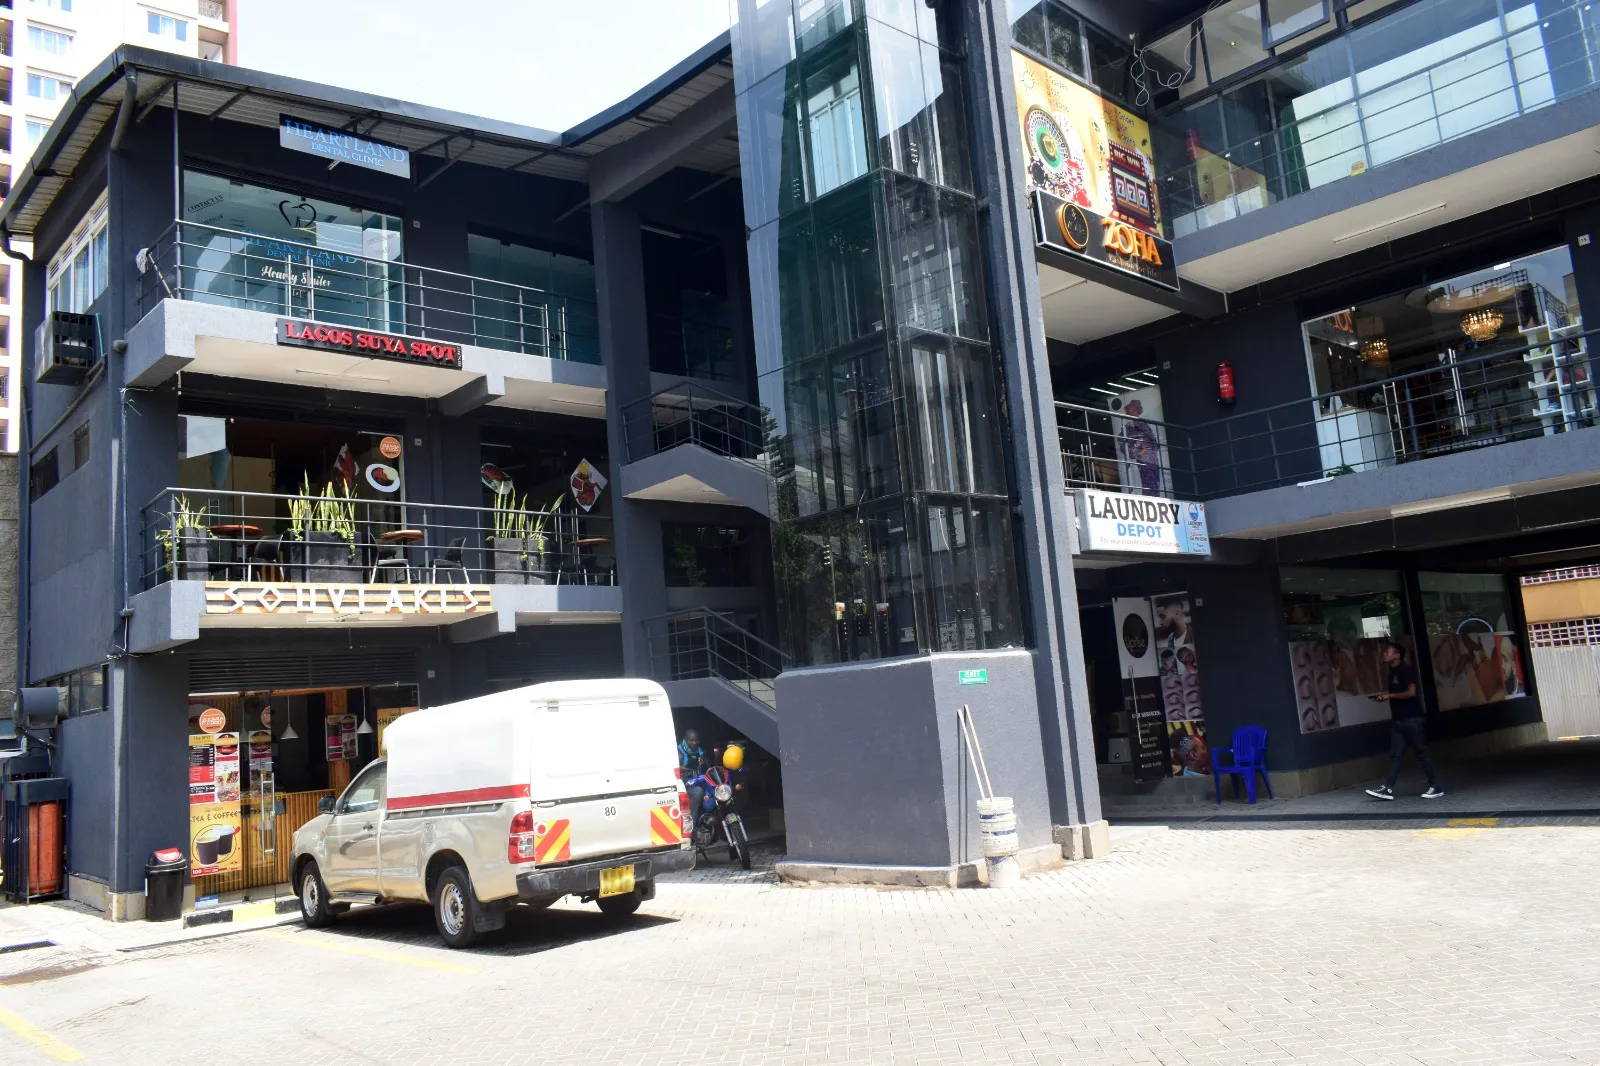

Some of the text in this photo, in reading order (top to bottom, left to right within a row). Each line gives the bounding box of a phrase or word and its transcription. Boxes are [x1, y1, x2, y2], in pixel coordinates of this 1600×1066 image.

[285, 119, 406, 162] HEARTLAND
[311, 141, 384, 167] DENTAL CLINIC
[187, 197, 214, 212] CONTACT
[284, 322, 353, 347] LAGOS
[356, 332, 408, 355] SUYA
[410, 341, 456, 362] SPOT
[1088, 495, 1180, 525] LAUNDRY
[1116, 523, 1162, 538] DEPOT
[965, 670, 980, 678] EXIT
[213, 811, 238, 820] COFFEE
[604, 806, 617, 817] 80
